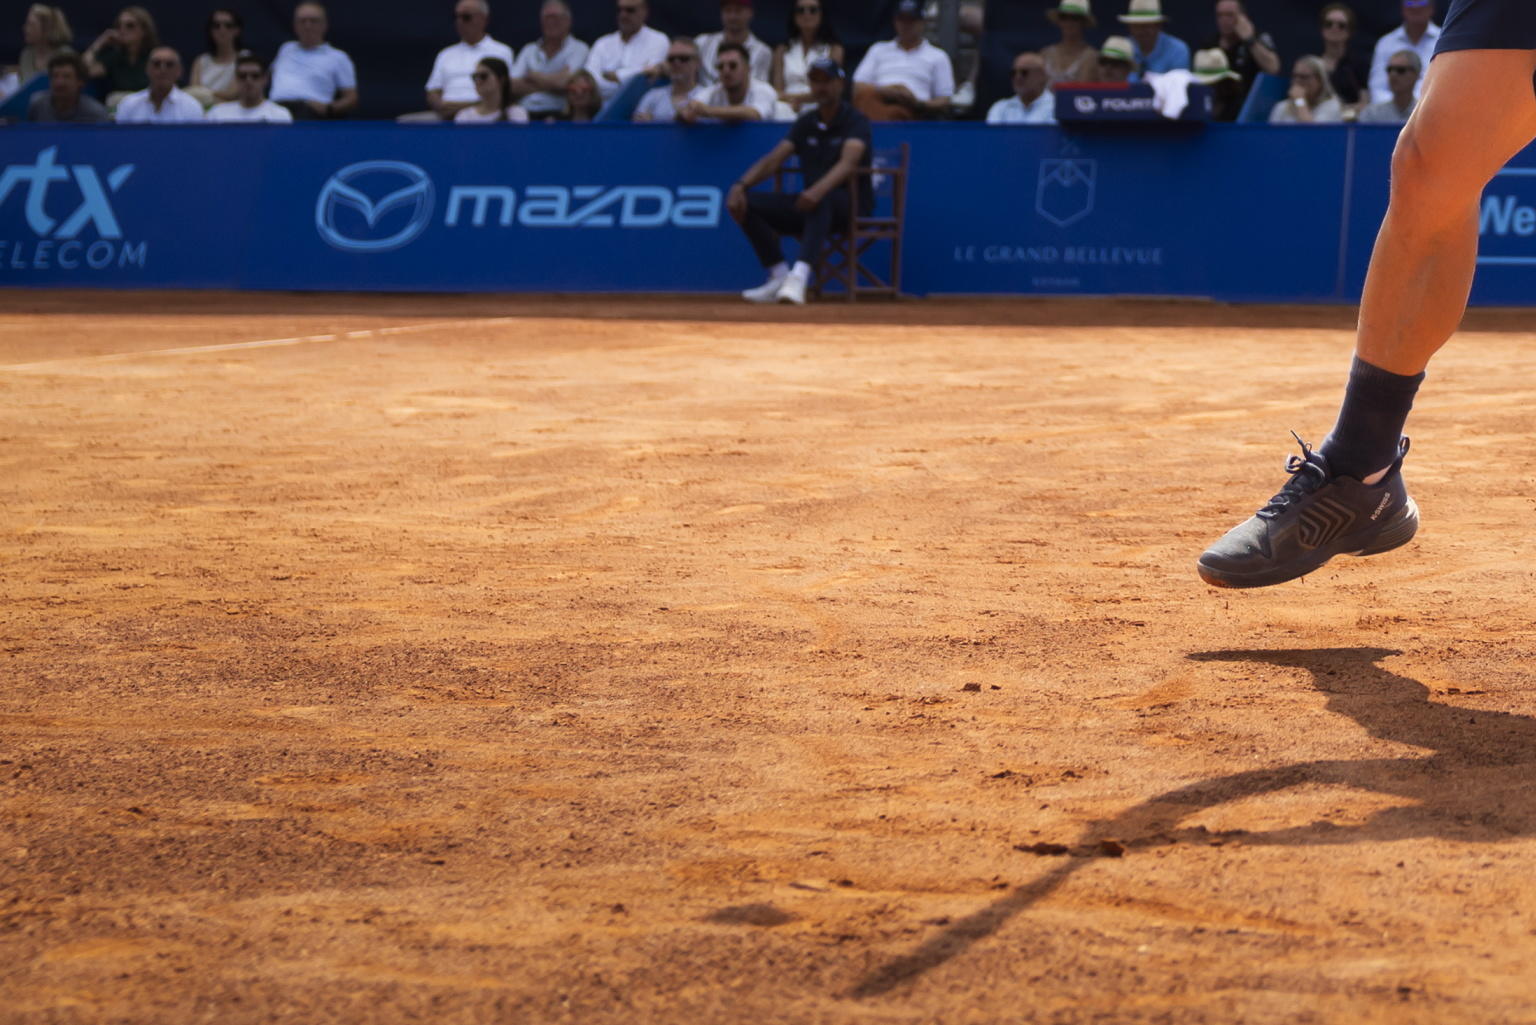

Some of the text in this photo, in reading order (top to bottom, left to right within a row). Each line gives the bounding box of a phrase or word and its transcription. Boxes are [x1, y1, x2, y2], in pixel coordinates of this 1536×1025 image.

[444, 185, 723, 228] mazda
[954, 246, 1163, 265] LE GRAND BELLEVUE
